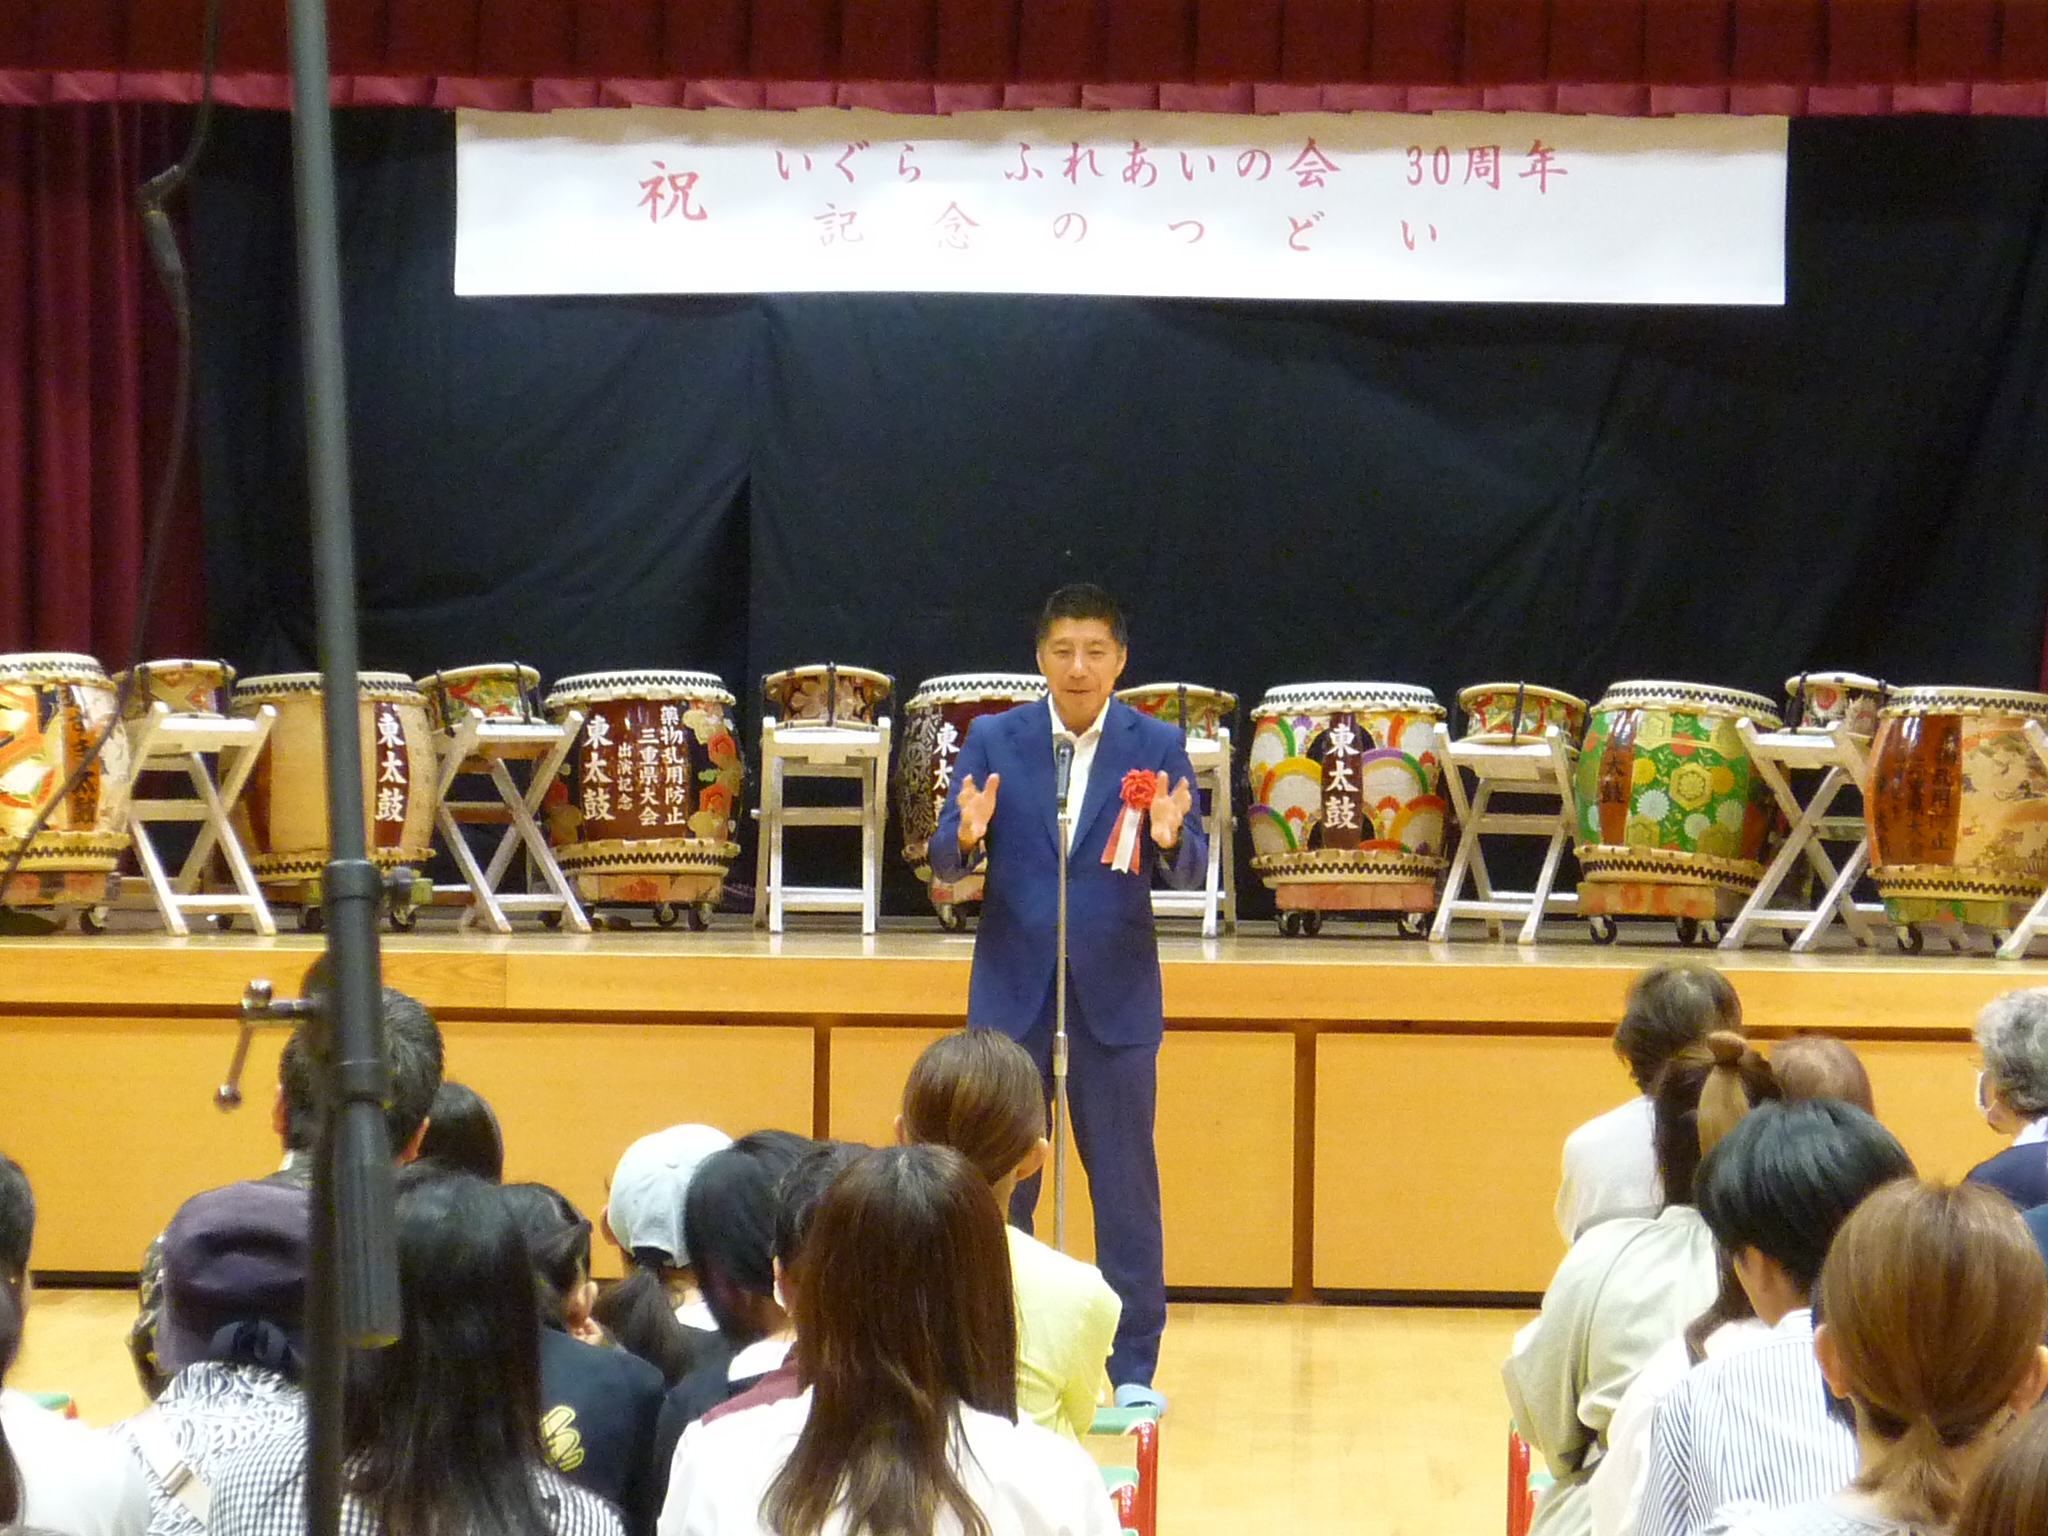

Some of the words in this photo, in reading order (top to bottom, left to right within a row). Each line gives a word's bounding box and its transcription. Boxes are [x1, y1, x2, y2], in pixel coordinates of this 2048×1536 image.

[638, 159, 709, 223] 祝
[775, 139, 922, 184] いぐら
[1004, 136, 1341, 189] ふれあいの会
[1405, 138, 1569, 194] 30周年
[375, 712, 407, 822] 東太鼓
[583, 714, 616, 821] 東太鼓
[617, 742, 633, 811] 出演記念
[638, 728, 660, 826] 三重県大会
[1324, 723, 1360, 829] 東太鼓
